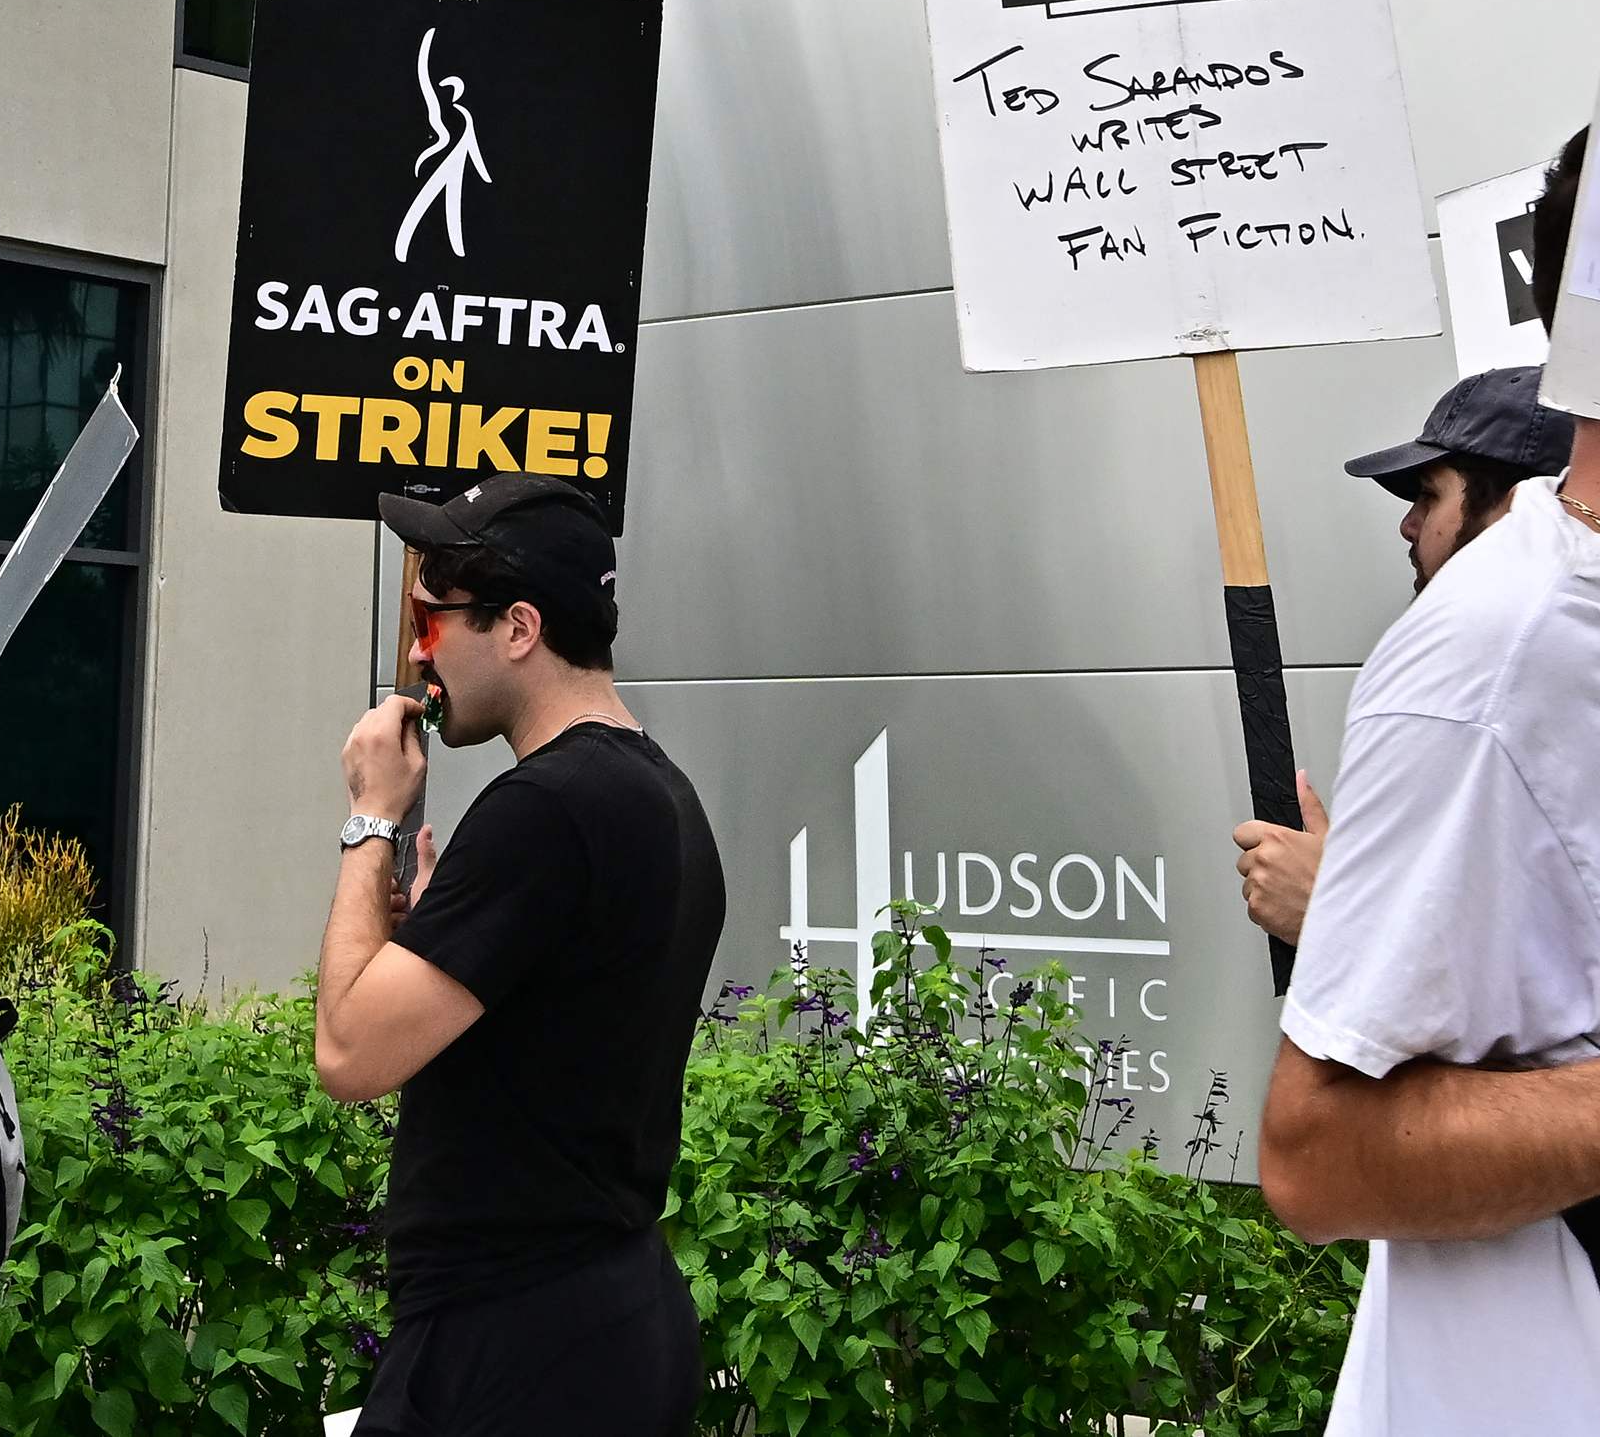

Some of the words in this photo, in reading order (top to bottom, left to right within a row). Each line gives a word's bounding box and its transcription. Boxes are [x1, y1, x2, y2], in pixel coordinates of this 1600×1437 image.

[1071, 104, 1221, 152] WRITES
[1014, 165, 1137, 211] WALL
[1169, 142, 1328, 187] STREET
[1058, 225, 1146, 270] FAN
[392, 356, 465, 394] ON
[240, 390, 613, 479] STRIKE!
